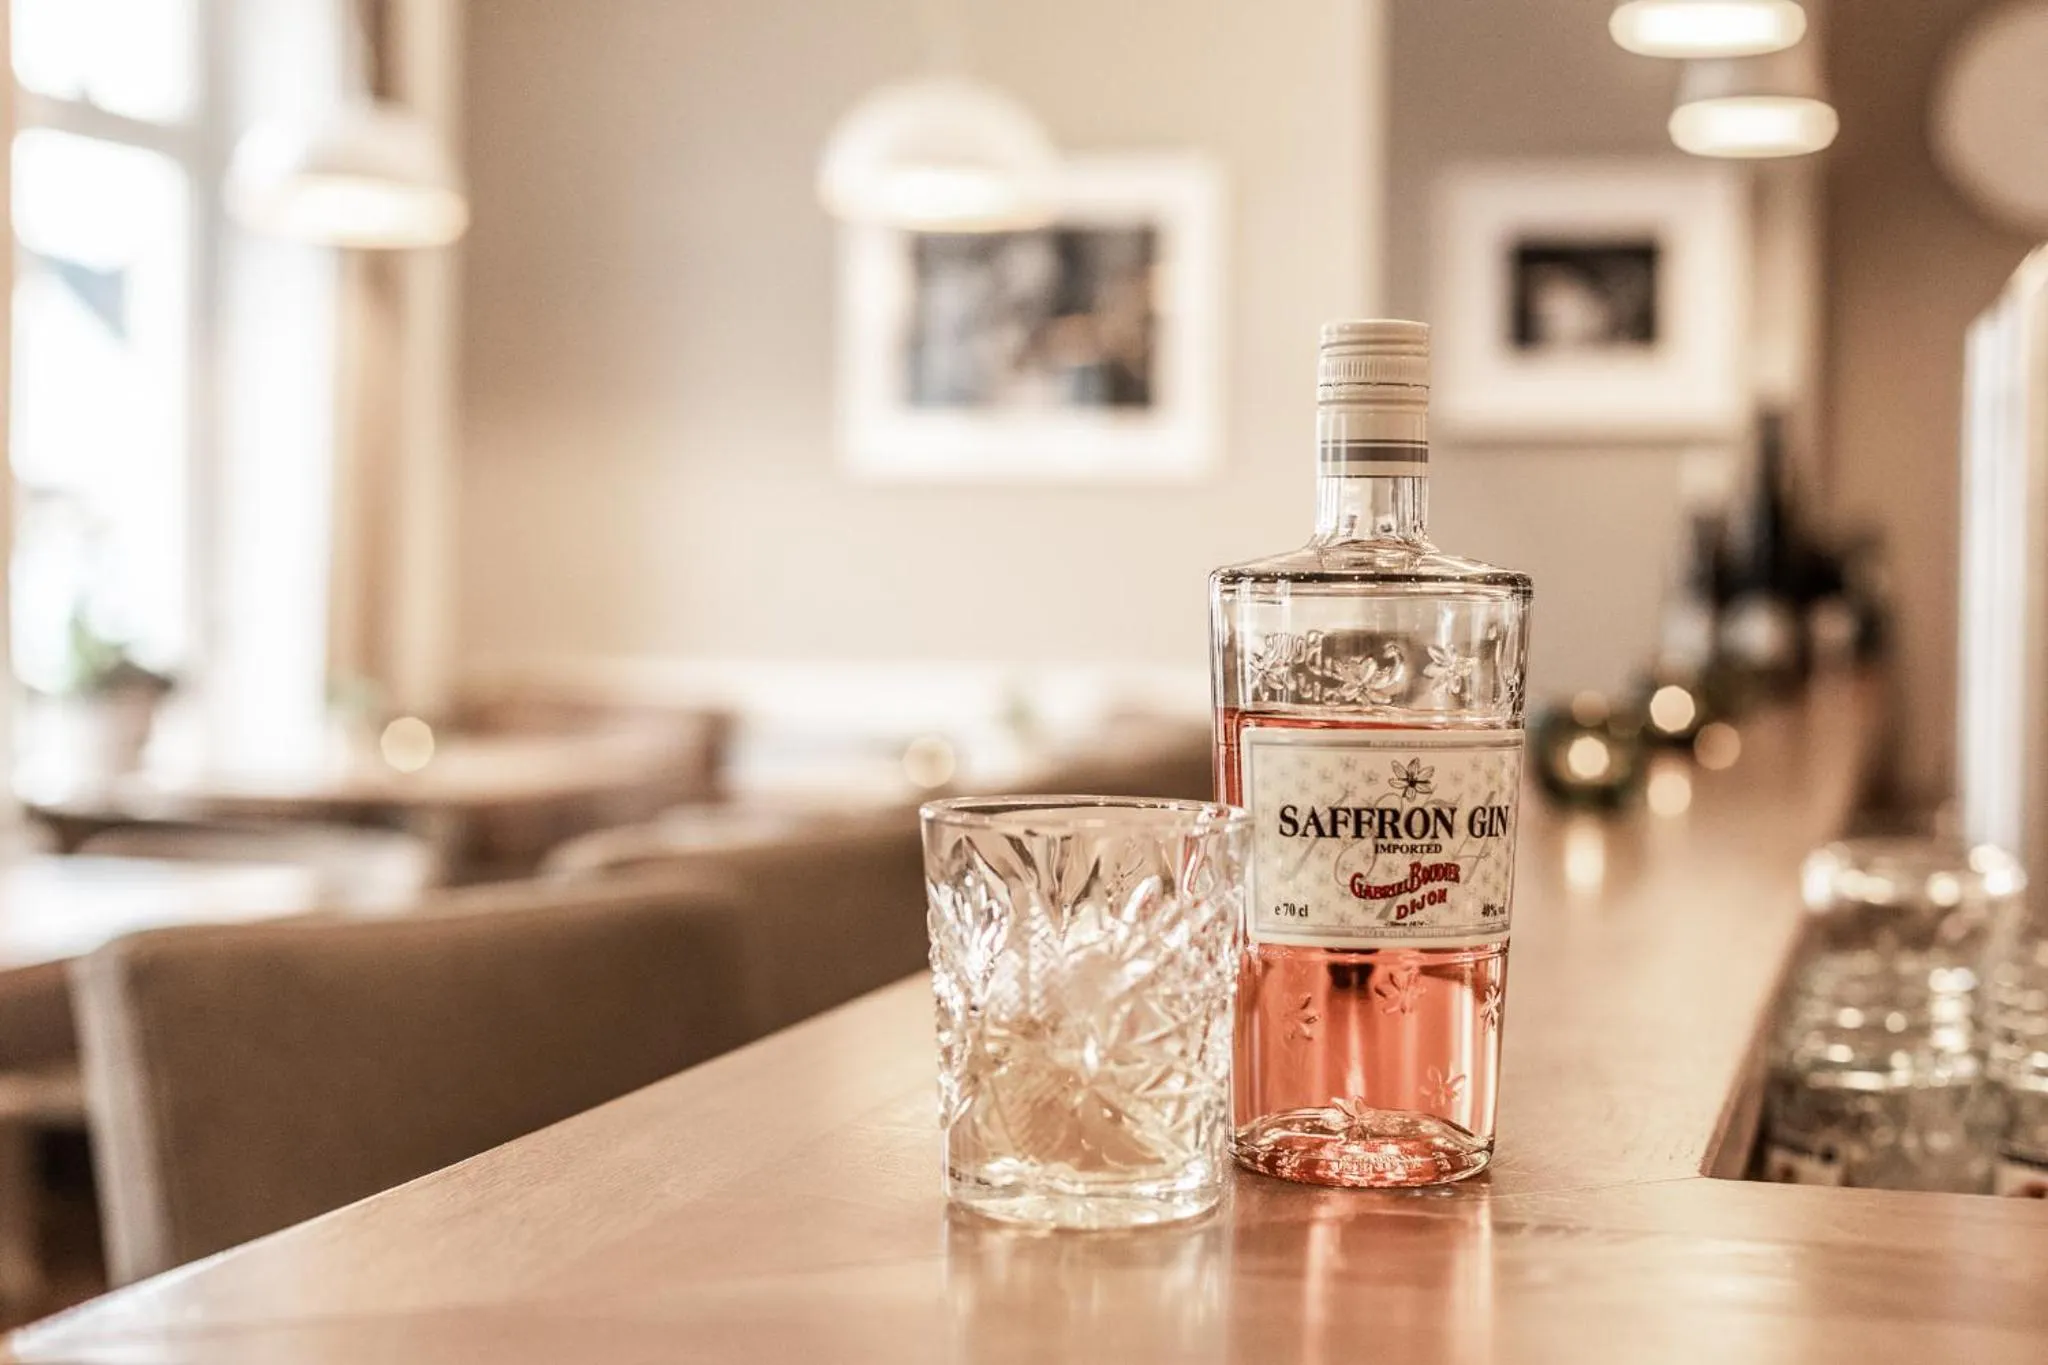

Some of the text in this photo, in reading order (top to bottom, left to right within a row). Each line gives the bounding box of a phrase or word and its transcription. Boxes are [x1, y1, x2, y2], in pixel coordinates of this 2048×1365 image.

[1278, 804, 1509, 840] SAFFRON GIN
[1374, 843, 1442, 854] IMPORTED
[1283, 903, 1296, 917] 70
[1299, 904, 1309, 917] cl
[1395, 887, 1447, 920] DIJON
